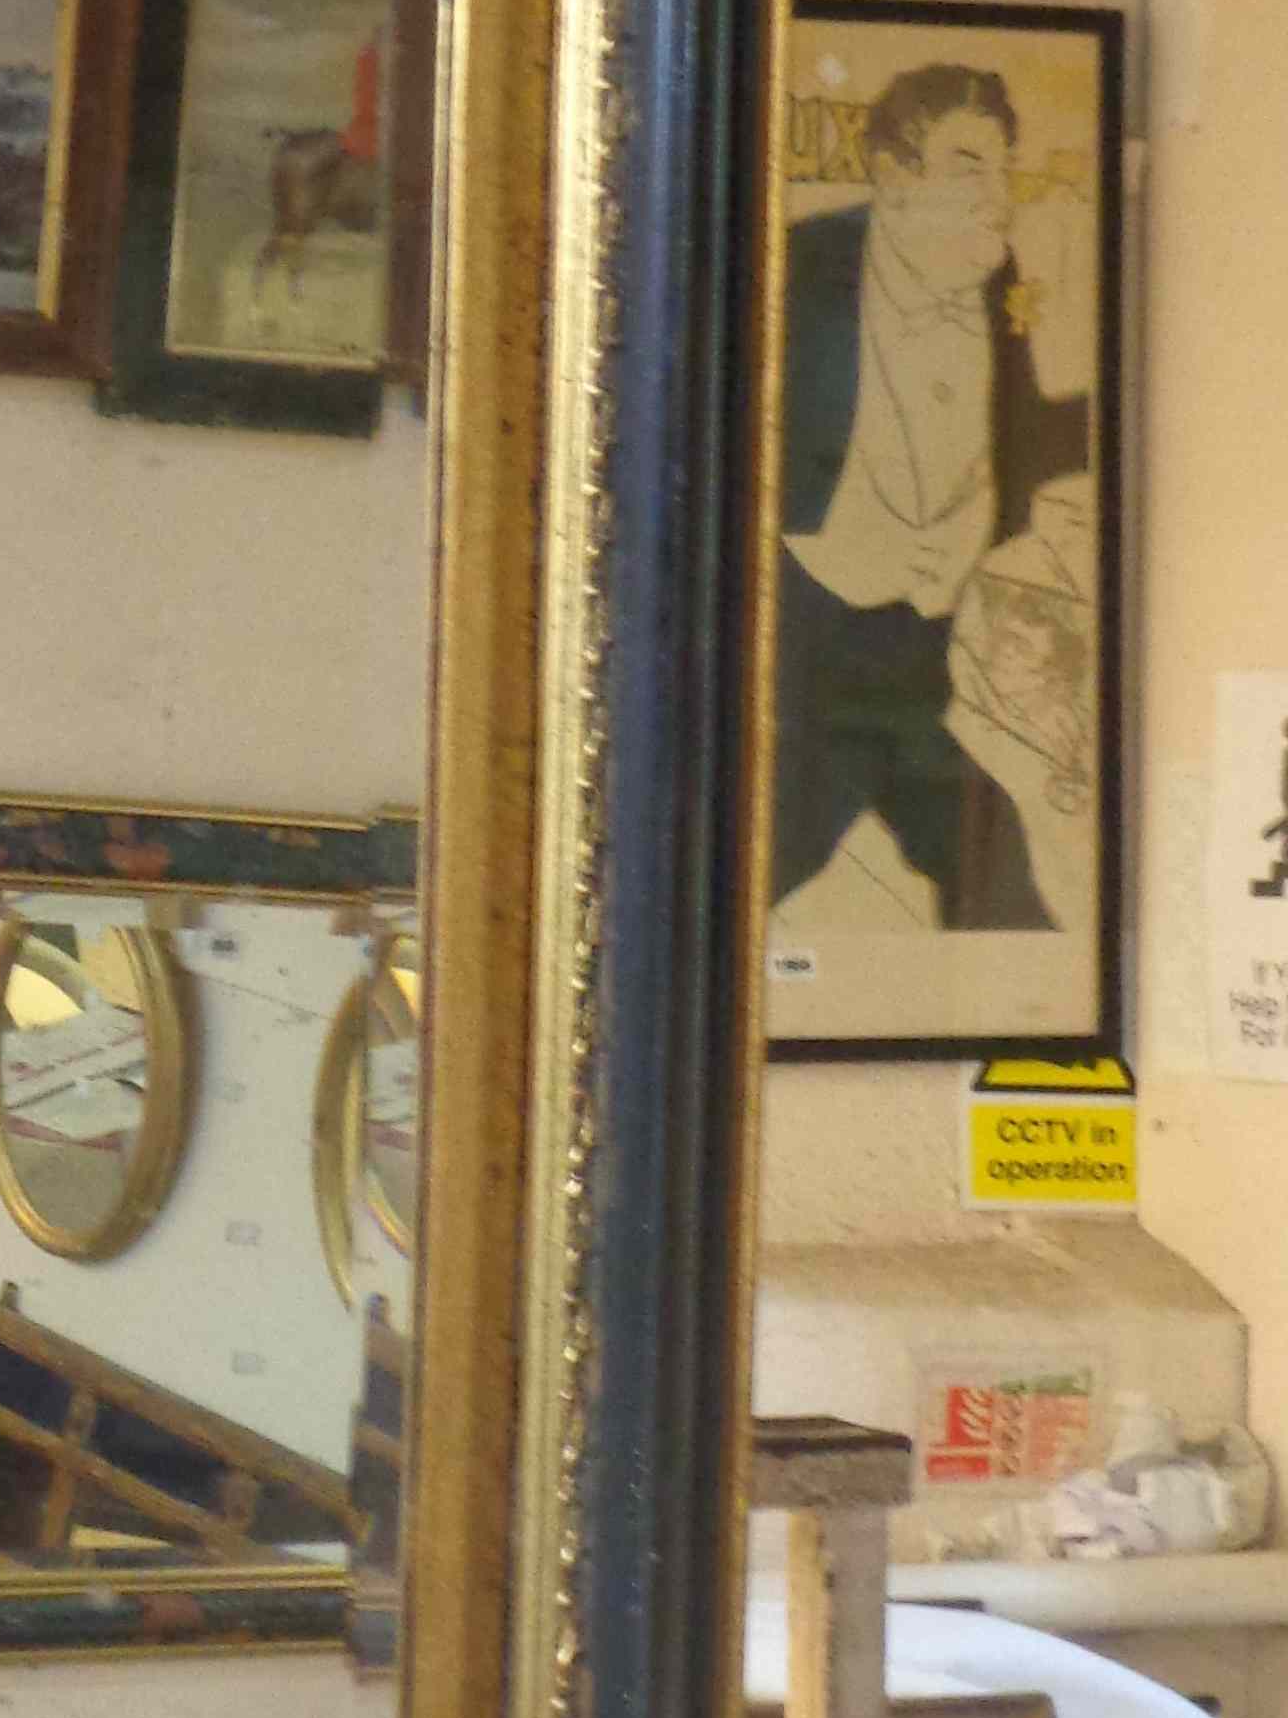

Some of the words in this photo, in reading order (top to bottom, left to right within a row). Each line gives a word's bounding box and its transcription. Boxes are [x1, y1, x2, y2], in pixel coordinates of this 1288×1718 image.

[996, 1117, 1081, 1144] CCTV
[1090, 1119, 1119, 1146] in
[986, 1157, 1128, 1186] operation
